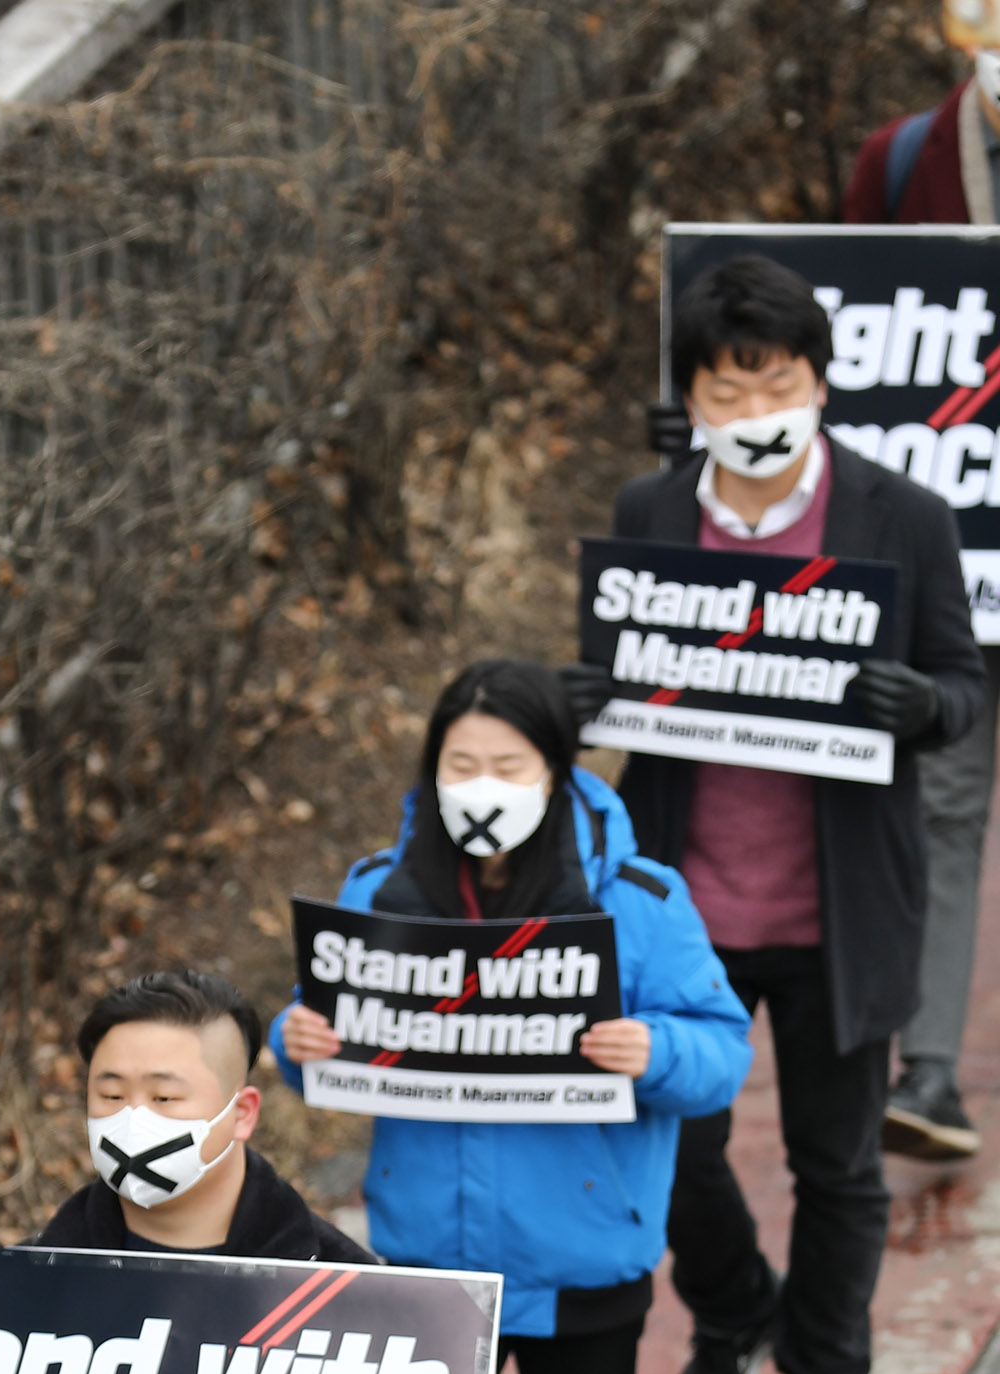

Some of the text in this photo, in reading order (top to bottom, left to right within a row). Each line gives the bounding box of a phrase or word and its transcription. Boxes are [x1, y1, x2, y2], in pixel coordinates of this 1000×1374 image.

[812, 286, 996, 392] ght
[592, 567, 882, 648] Stand with
[612, 629, 860, 705] Myanmar
[310, 930, 601, 1000] Stand with
[334, 993, 587, 1056] Myanmar
